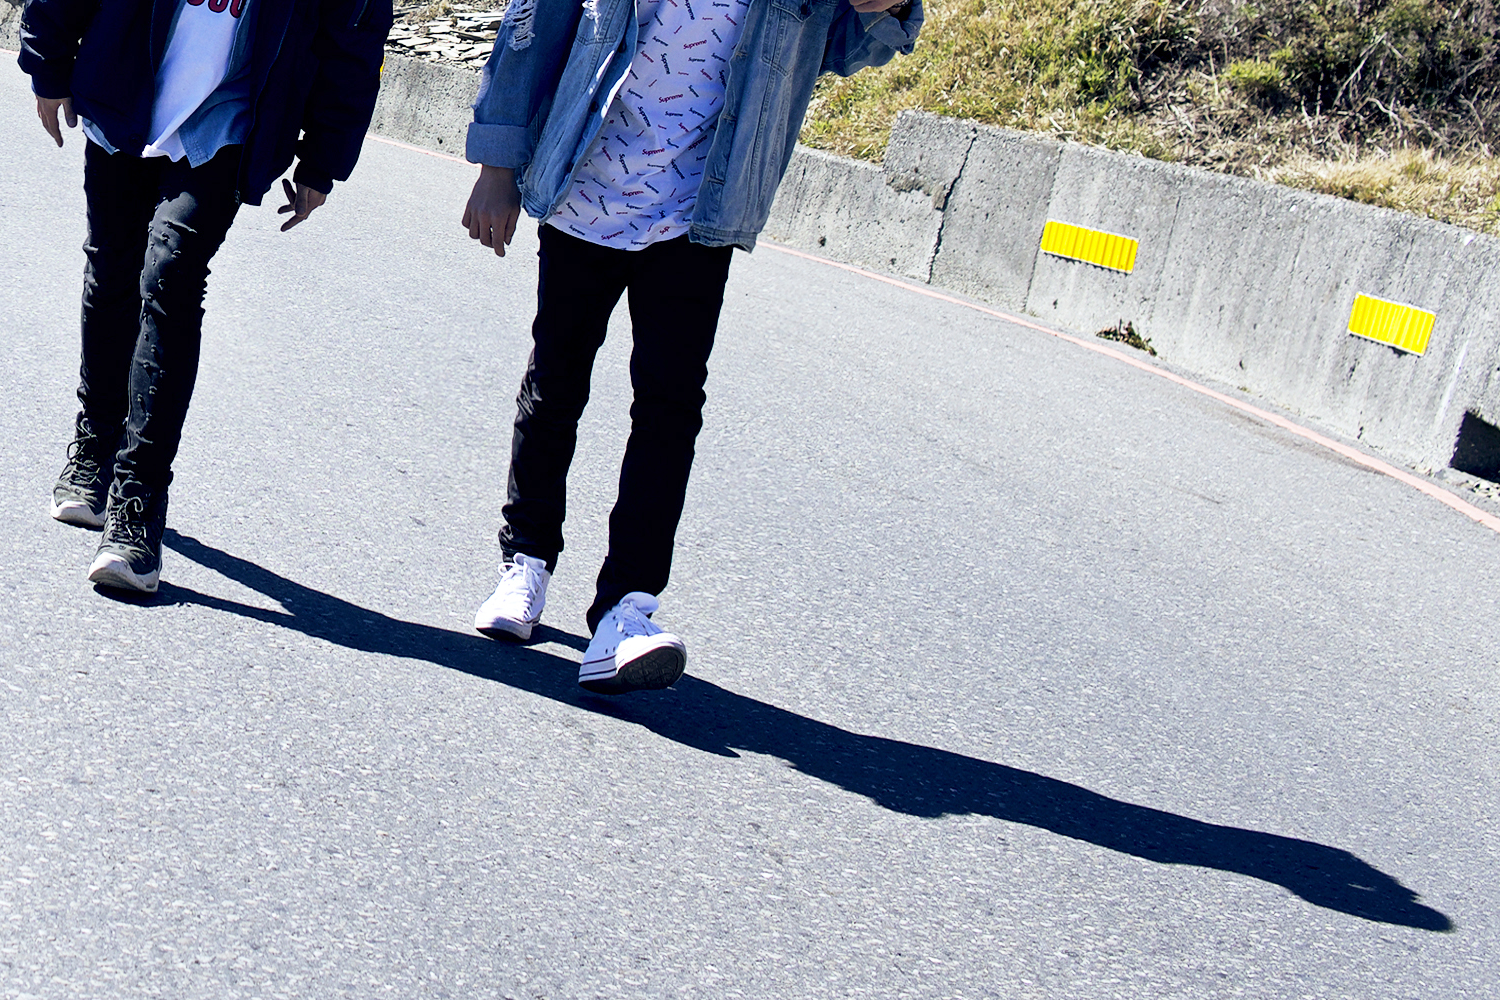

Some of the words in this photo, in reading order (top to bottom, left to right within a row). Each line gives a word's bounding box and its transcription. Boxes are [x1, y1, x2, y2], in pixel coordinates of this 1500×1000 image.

[683, 39, 707, 49] Supreme
[661, 53, 670, 74] Supreme
[659, 94, 683, 103] Supreme
[638, 106, 651, 127] Supreme
[642, 148, 665, 156] Supreme
[619, 154, 629, 174] Supreme
[601, 230, 624, 240] Supreme
